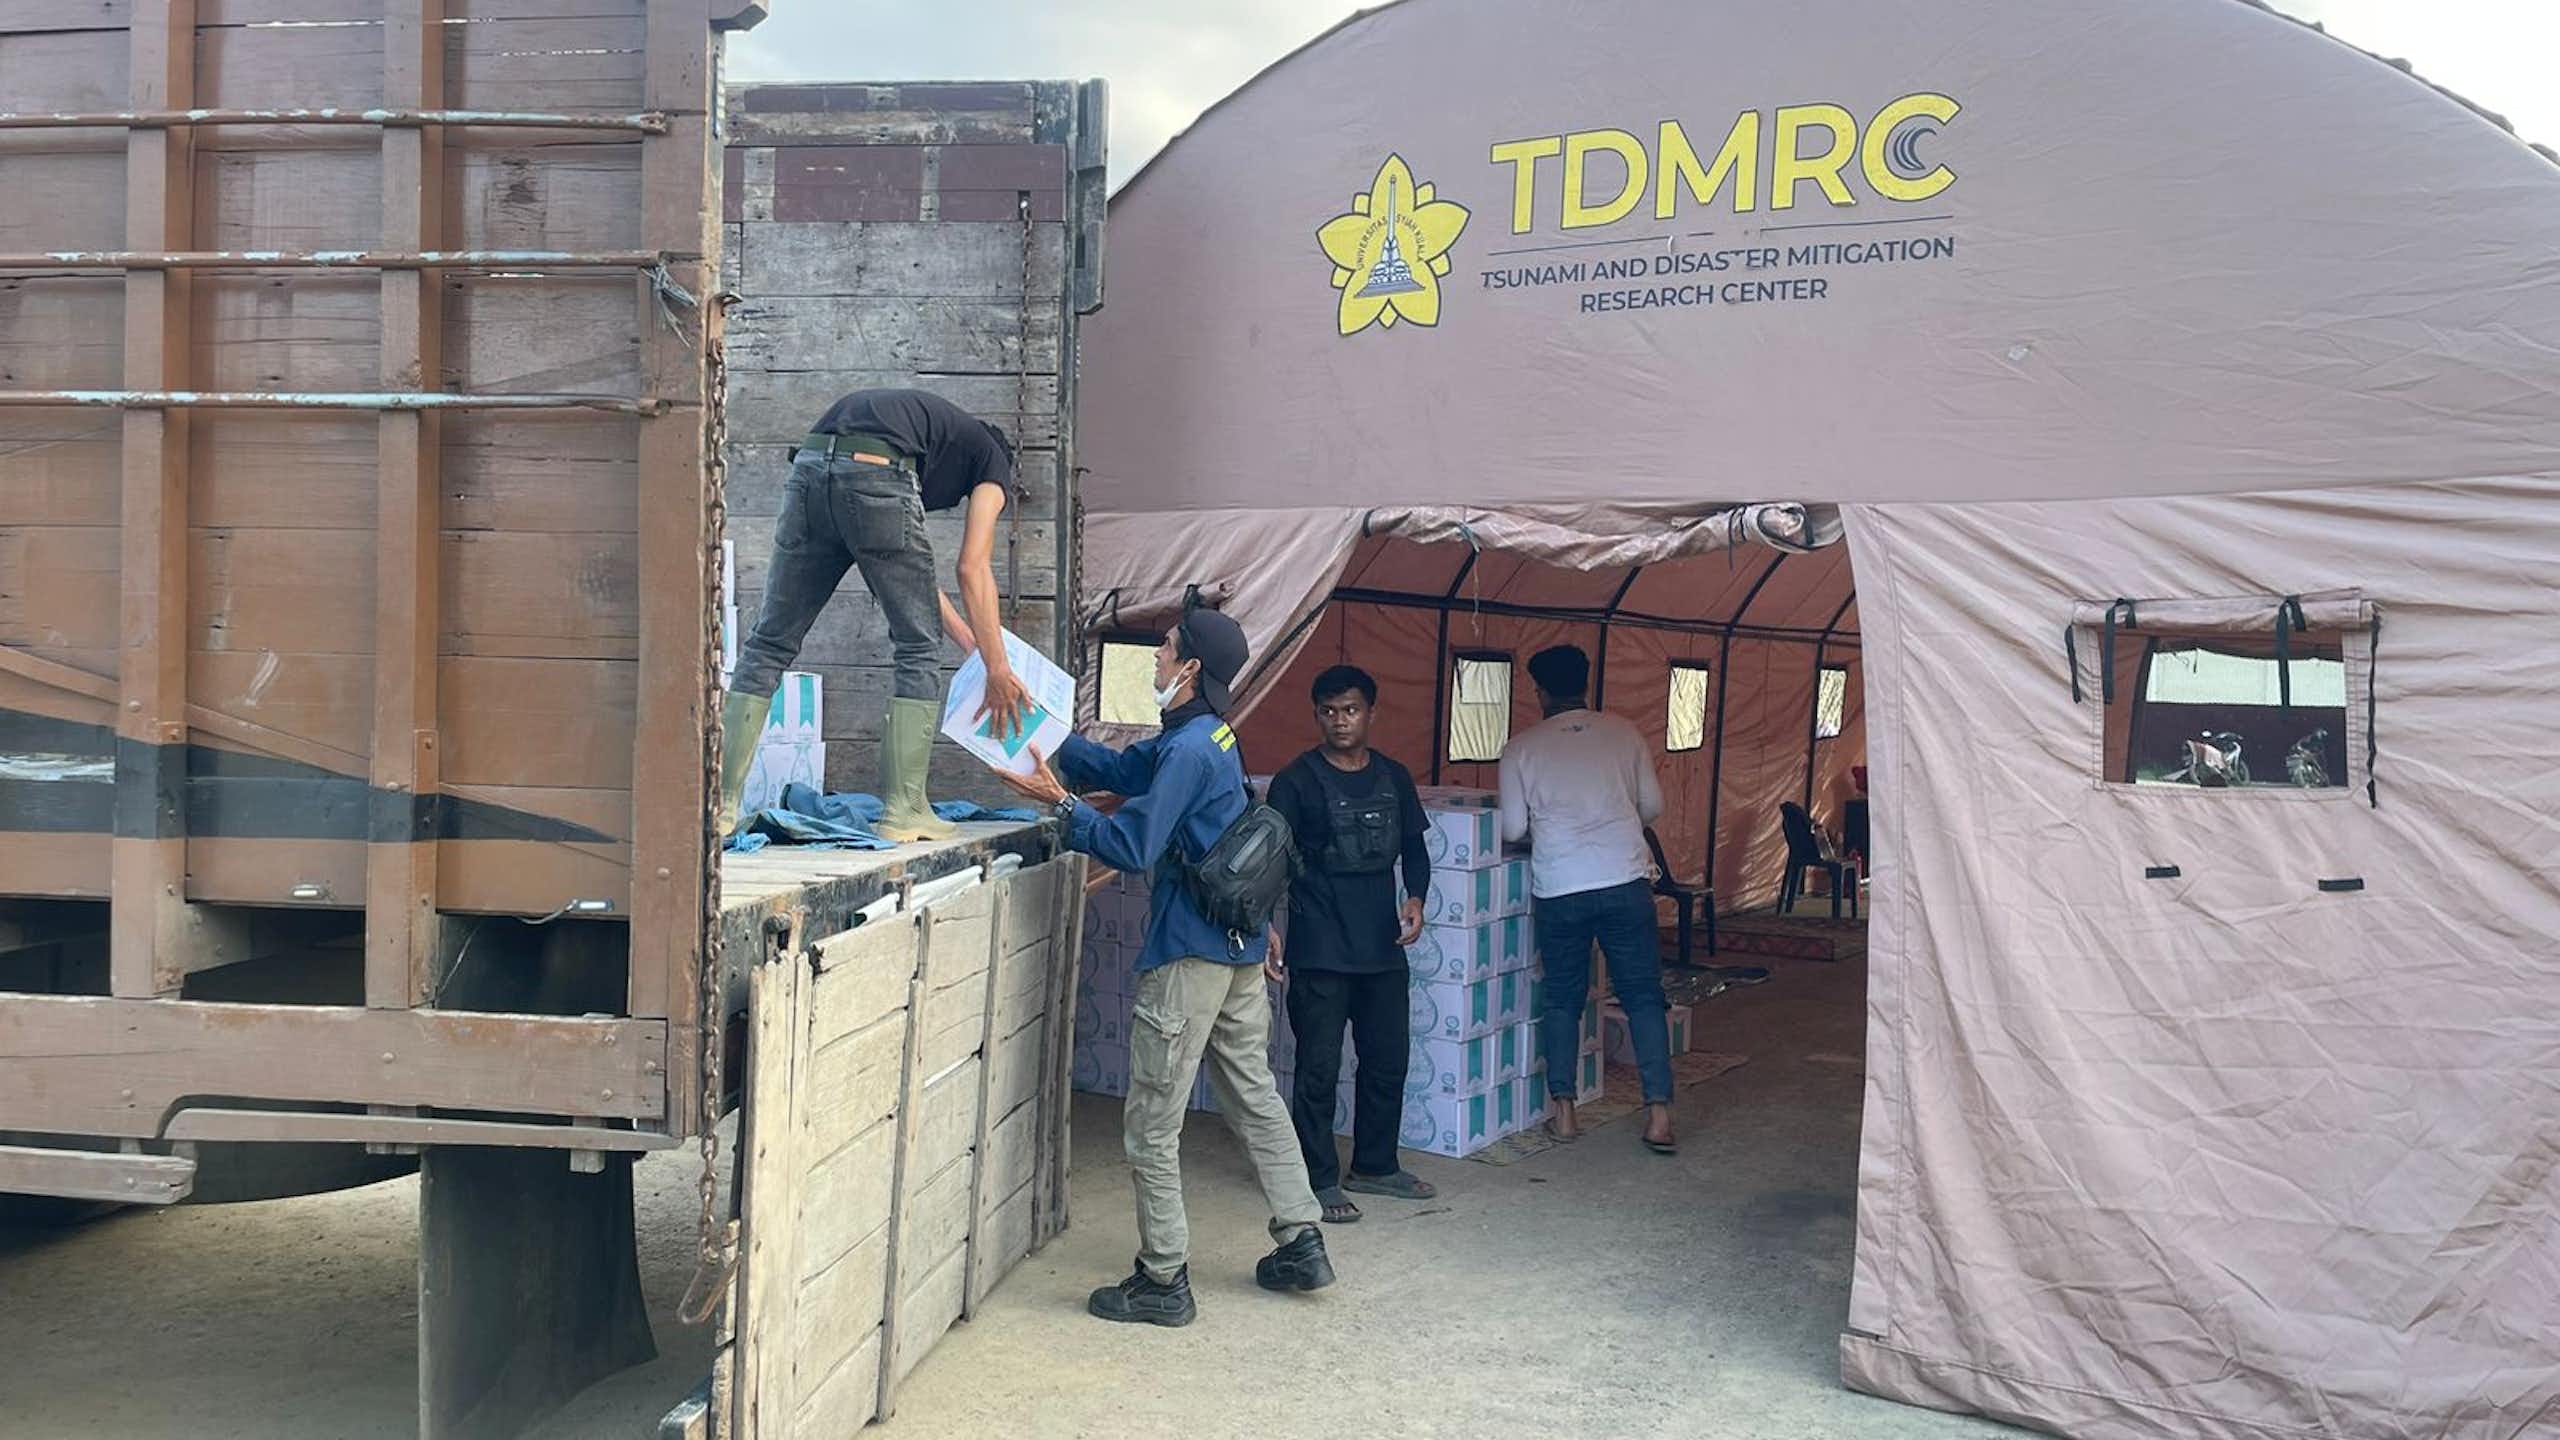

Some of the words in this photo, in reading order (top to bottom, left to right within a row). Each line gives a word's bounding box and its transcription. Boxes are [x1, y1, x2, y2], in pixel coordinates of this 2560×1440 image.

[1490, 91, 1963, 236] TDMRC
[1357, 215, 1388, 271] UNIVERSITAS
[1480, 262, 1586, 290] TSUNAMI
[1591, 257, 1648, 281] AND
[1787, 236, 1955, 267] MITIGATION
[1580, 284, 1715, 313] RESEARCH
[1720, 278, 1828, 305] CENTER
